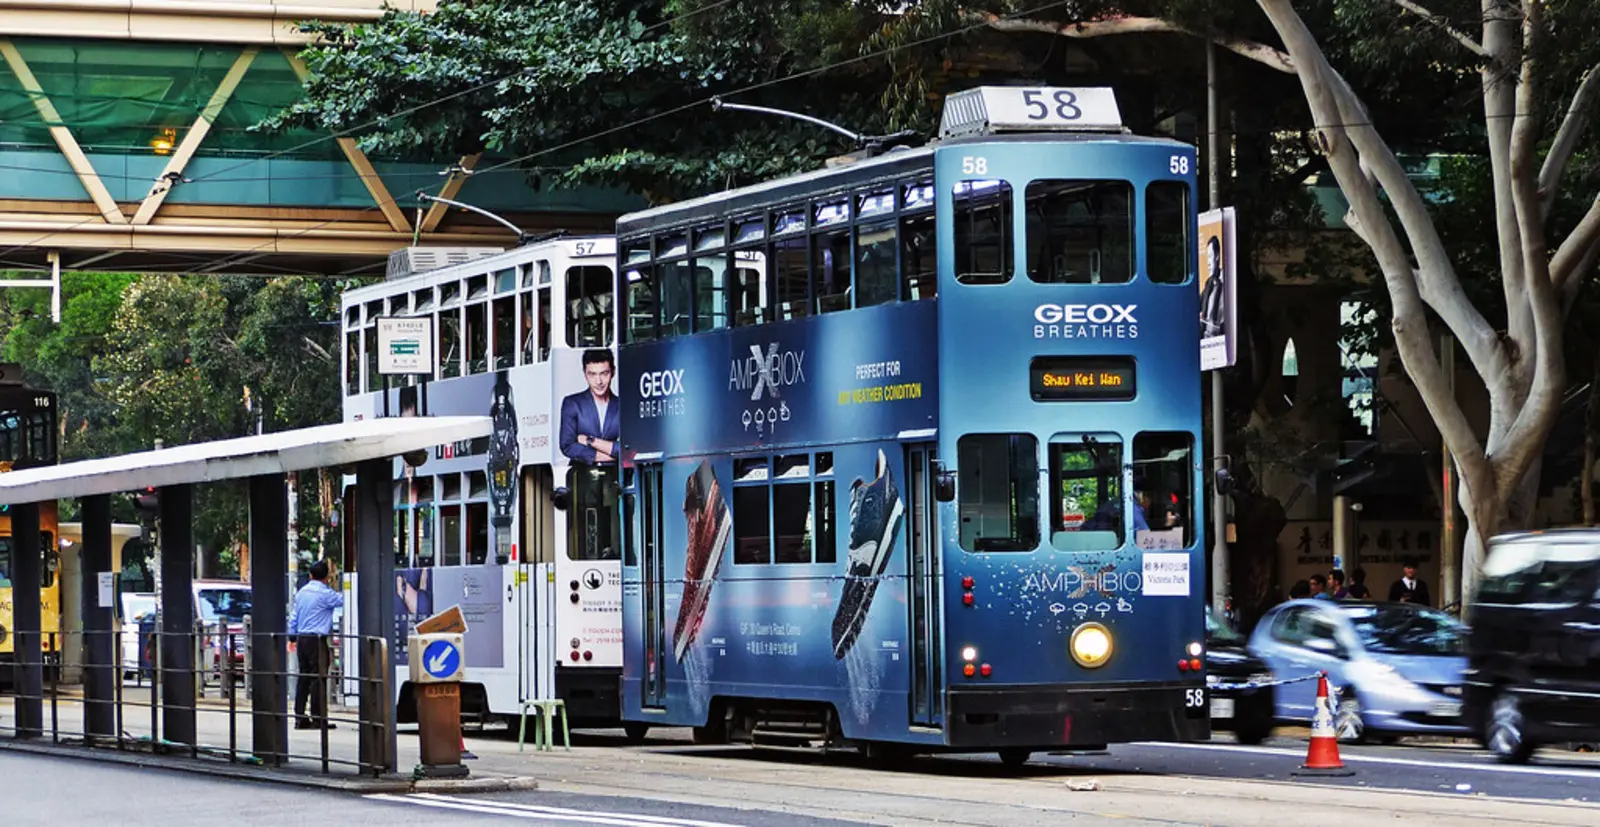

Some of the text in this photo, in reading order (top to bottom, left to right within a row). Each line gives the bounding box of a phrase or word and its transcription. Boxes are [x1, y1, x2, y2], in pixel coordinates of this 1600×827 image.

[1022, 90, 1082, 120] 58
[962, 156, 988, 174] 58
[1169, 155, 1189, 174] 58
[575, 242, 596, 255] 57
[1034, 304, 1138, 324] GEOX
[1034, 325, 1138, 338] BREATHES
[855, 361, 901, 380] PERFECT FOR
[1043, 373, 1122, 386] Shau Kei Wan
[639, 369, 685, 398] GEOX
[34, 396, 50, 407] 116
[852, 387, 883, 404] WEATHER
[884, 383, 922, 401] CONDITION
[639, 399, 685, 418] BREATHES
[1024, 570, 1143, 593] AMPHIBIO
[1185, 688, 1204, 707] 58
